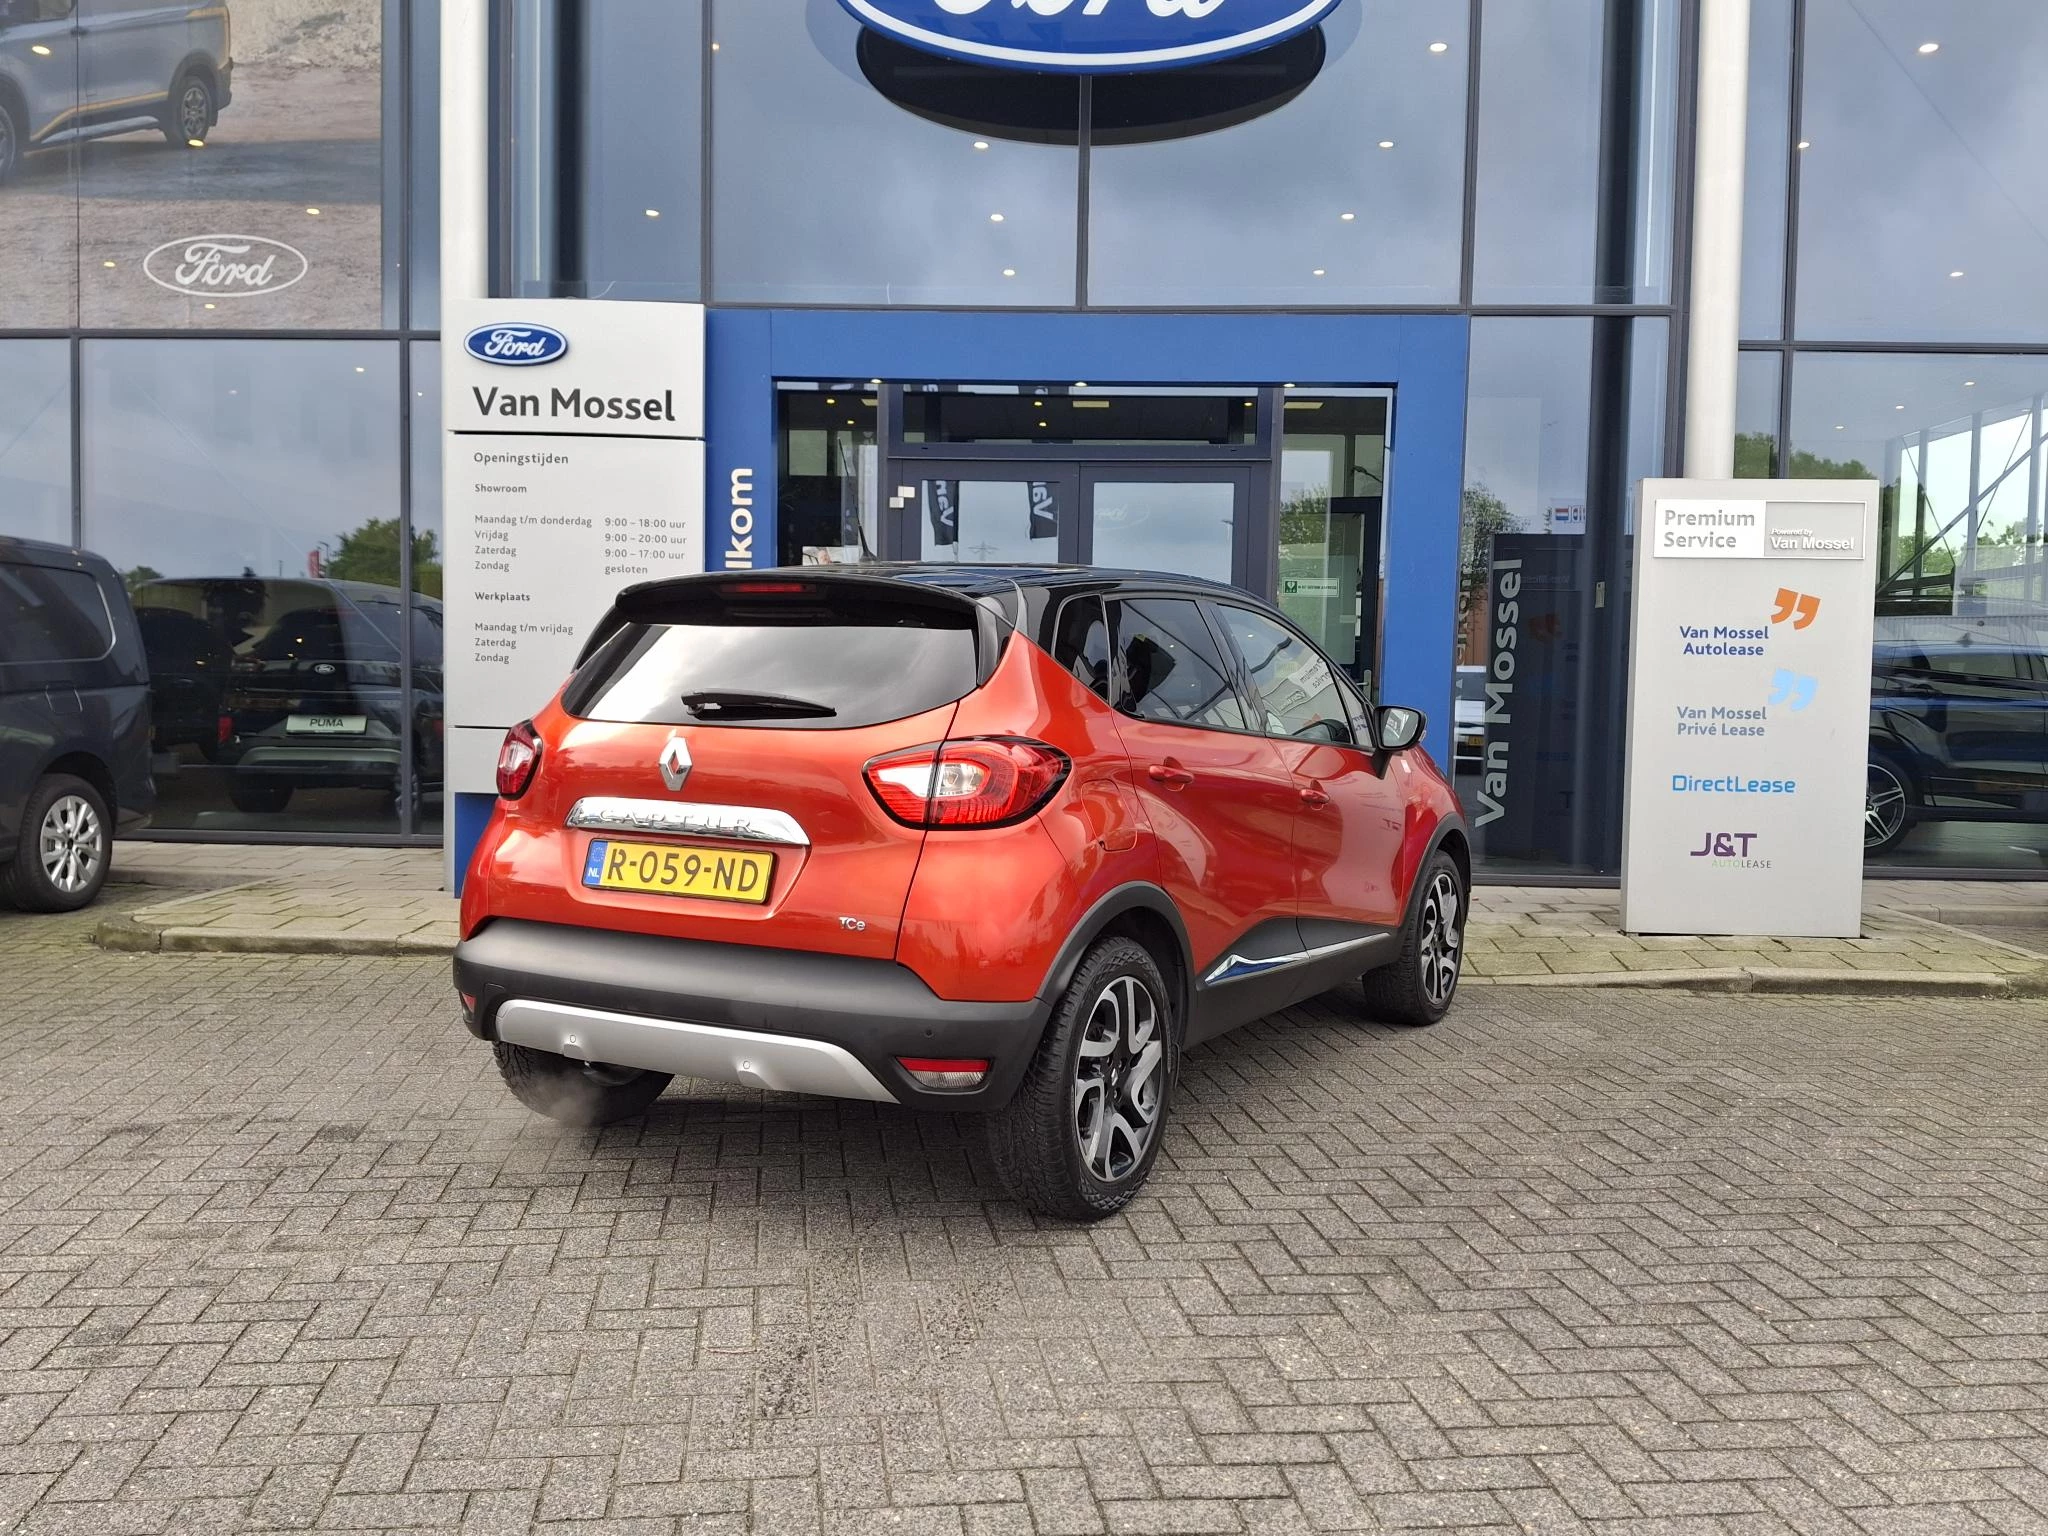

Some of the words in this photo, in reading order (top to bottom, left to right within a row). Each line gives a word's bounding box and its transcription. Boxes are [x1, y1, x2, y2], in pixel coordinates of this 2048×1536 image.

[175, 243, 276, 286] Ford
[484, 329, 546, 356] Ford
[472, 386, 539, 416] Van
[551, 387, 676, 421] Mossel
[473, 452, 569, 466] Openingstijden
[474, 484, 527, 493] Showroom
[474, 515, 517, 526] Maandag
[520, 515, 537, 524] t/m
[540, 515, 592, 528] donderdag
[604, 518, 627, 527] 9:00
[639, 518, 667, 528] 18:00
[725, 468, 753, 569] lkom
[1664, 509, 1755, 526] Premium
[474, 530, 509, 541] Vrijdag
[604, 533, 627, 542] 9:00
[638, 534, 668, 544] 20:00
[1664, 531, 1737, 548] Service
[1770, 528, 1802, 536] Powered
[1804, 528, 1813, 537] by
[1771, 537, 1797, 549] Van
[1802, 537, 1854, 550] Mossel
[474, 545, 517, 557] Zaterdag
[604, 549, 627, 558] 9:00
[639, 549, 666, 559] 17:00
[668, 552, 686, 560] uur
[474, 561, 510, 572] Zondag
[604, 565, 648, 575] gesloten
[474, 592, 531, 603] Werkplaats
[474, 622, 517, 634] Maandag
[520, 624, 537, 632] t/m
[540, 624, 574, 635] vrijdag
[1680, 626, 1708, 639] Van
[1713, 626, 1769, 639] Mossel
[474, 638, 517, 649] Zaterdag
[1484, 559, 1523, 724] Mossel
[1683, 643, 1764, 656] Autolease
[474, 653, 510, 664] Zondag
[1677, 706, 1706, 719] Van
[1711, 706, 1767, 720] Mossel
[309, 718, 344, 727] PUMA
[1677, 722, 1717, 736] Privé
[1721, 723, 1765, 736] Lease
[1475, 741, 1509, 828] Van
[1672, 775, 1796, 793] DirectLease
[1690, 832, 1757, 857] J&T
[607, 848, 759, 892] R-059-ND
[1712, 859, 1772, 869] AUTOLEASE
[588, 868, 599, 878] NL
[839, 916, 866, 931] TCe
